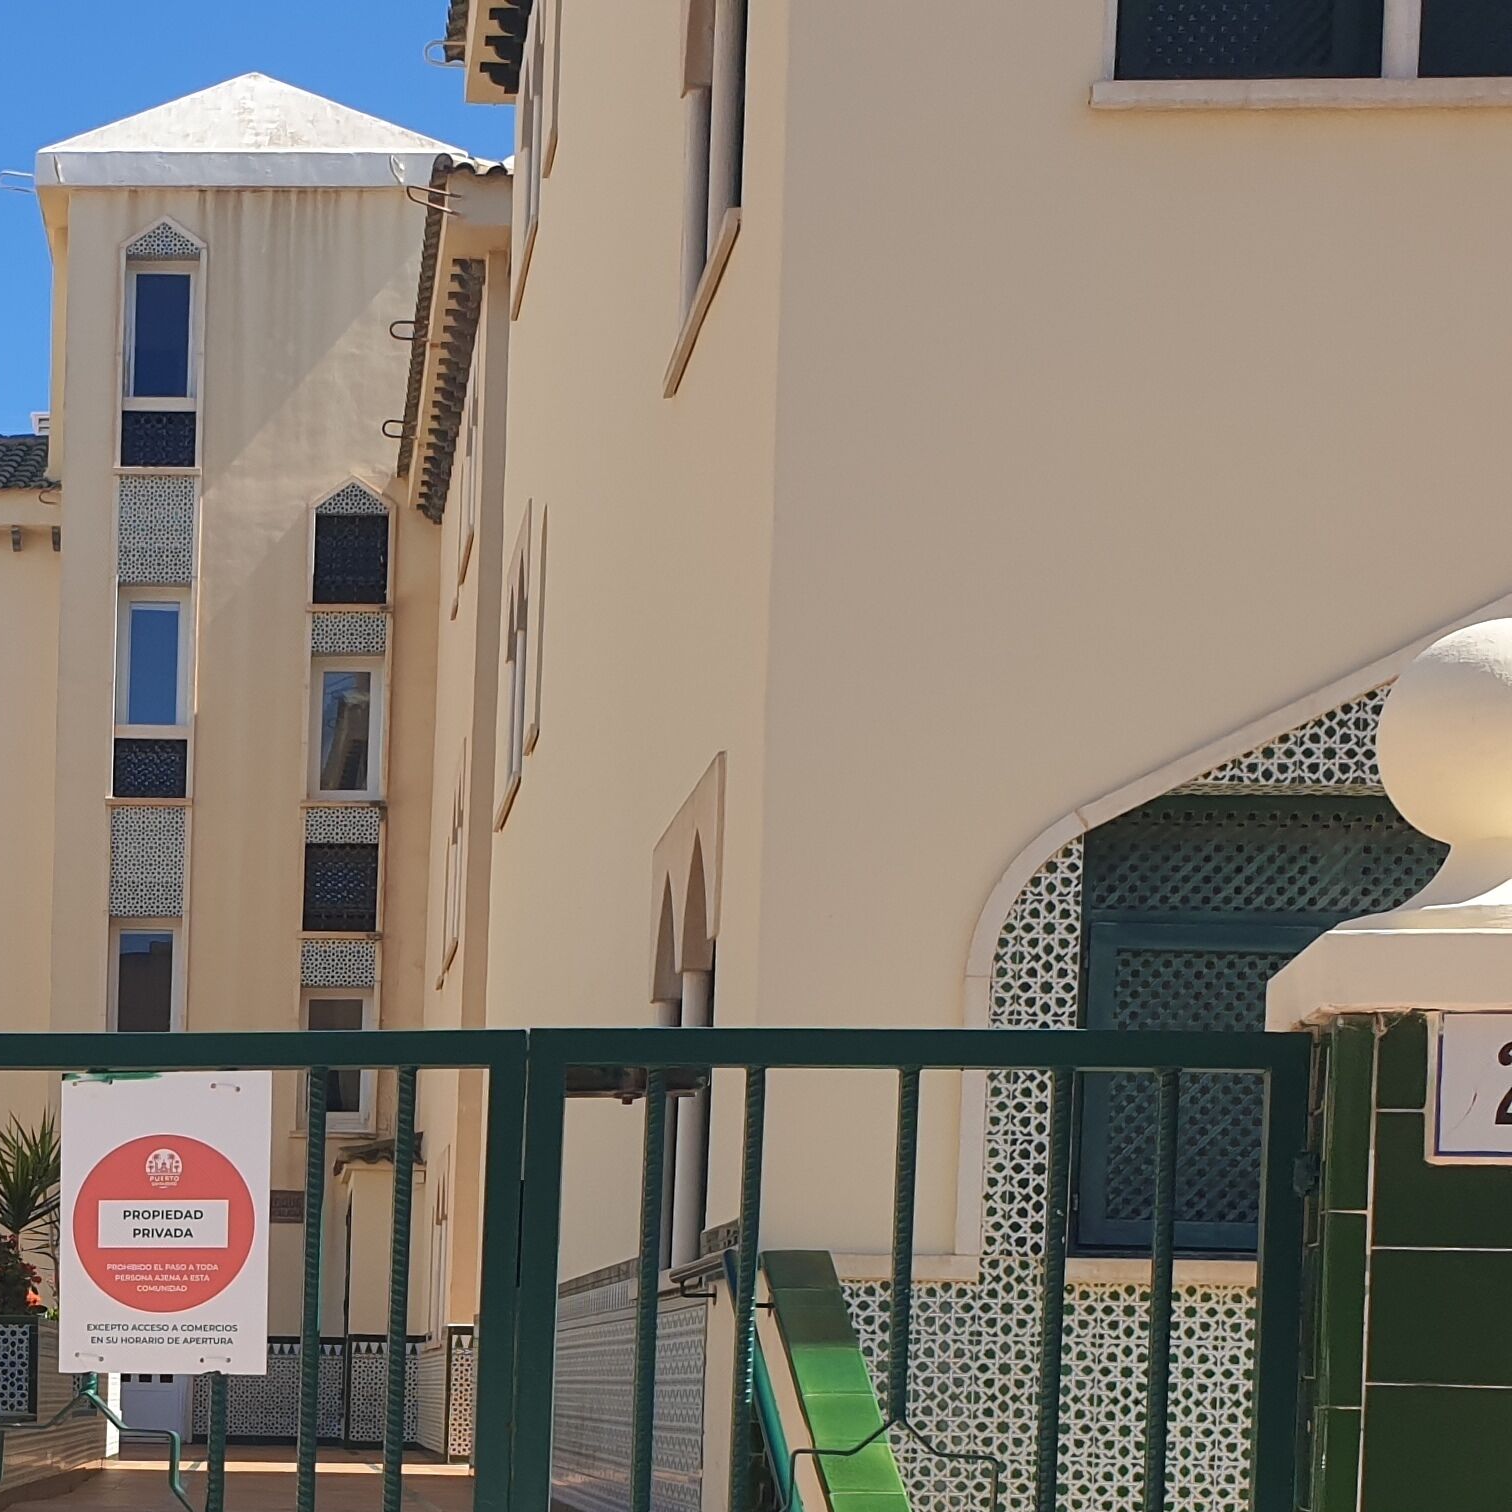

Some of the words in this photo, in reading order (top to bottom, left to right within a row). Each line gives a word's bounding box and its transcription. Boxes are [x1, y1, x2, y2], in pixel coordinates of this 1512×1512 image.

[123, 1209, 204, 1220] PROPIEDAD
[132, 1227, 194, 1239] PRIVADA
[106, 1263, 152, 1271] PROHIBIDO
[153, 1263, 164, 1271] EL
[165, 1263, 187, 1271] PASO
[188, 1263, 195, 1271] A
[114, 1274, 153, 1282] PERSONA
[154, 1274, 181, 1282] AJENA
[182, 1274, 189, 1282] A
[190, 1274, 210, 1282] ESTA
[87, 1324, 129, 1332] EXCEPTO
[131, 1324, 170, 1332] ACCESO
[171, 1324, 179, 1332] A
[180, 1324, 238, 1332] COMERCIOS
[90, 1336, 104, 1344] EN
[106, 1336, 118, 1344] SU
[120, 1337, 165, 1345] HORARIO
[167, 1337, 180, 1345] DE
[182, 1337, 234, 1345] APERTURA
